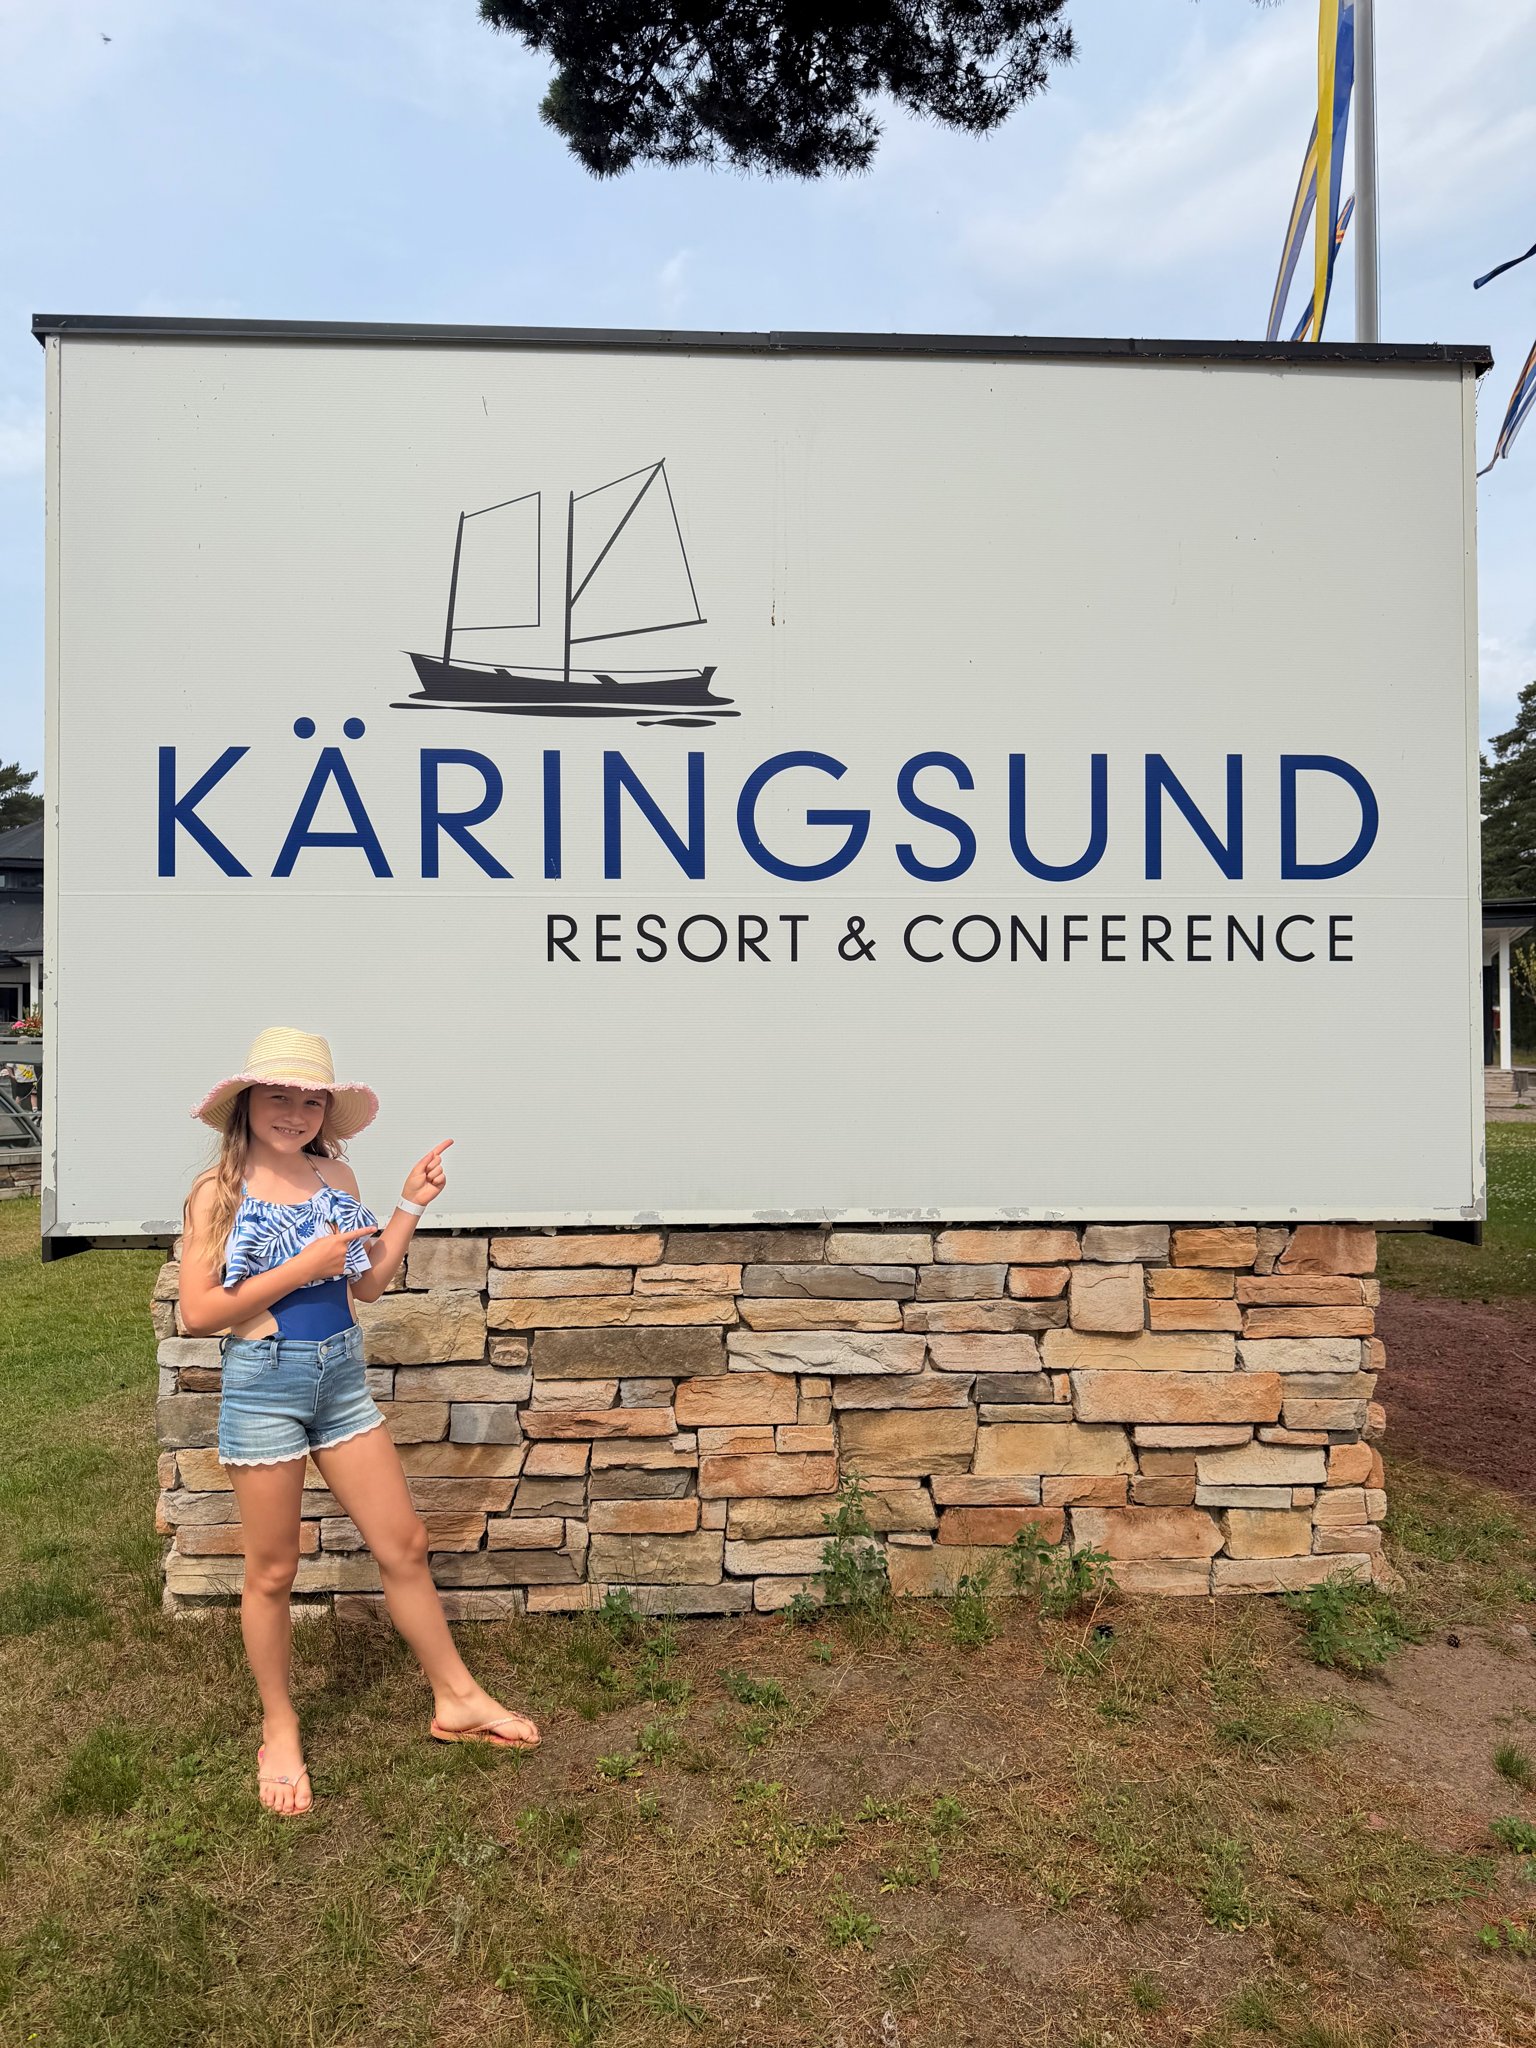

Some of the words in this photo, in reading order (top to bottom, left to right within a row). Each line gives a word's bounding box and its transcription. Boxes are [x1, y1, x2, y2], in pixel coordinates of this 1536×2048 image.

[158, 716, 1379, 883] KÄRINGSUND
[547, 914, 809, 963] RESORT
[837, 915, 876, 962] &
[903, 914, 1353, 963] CONFERENCE
